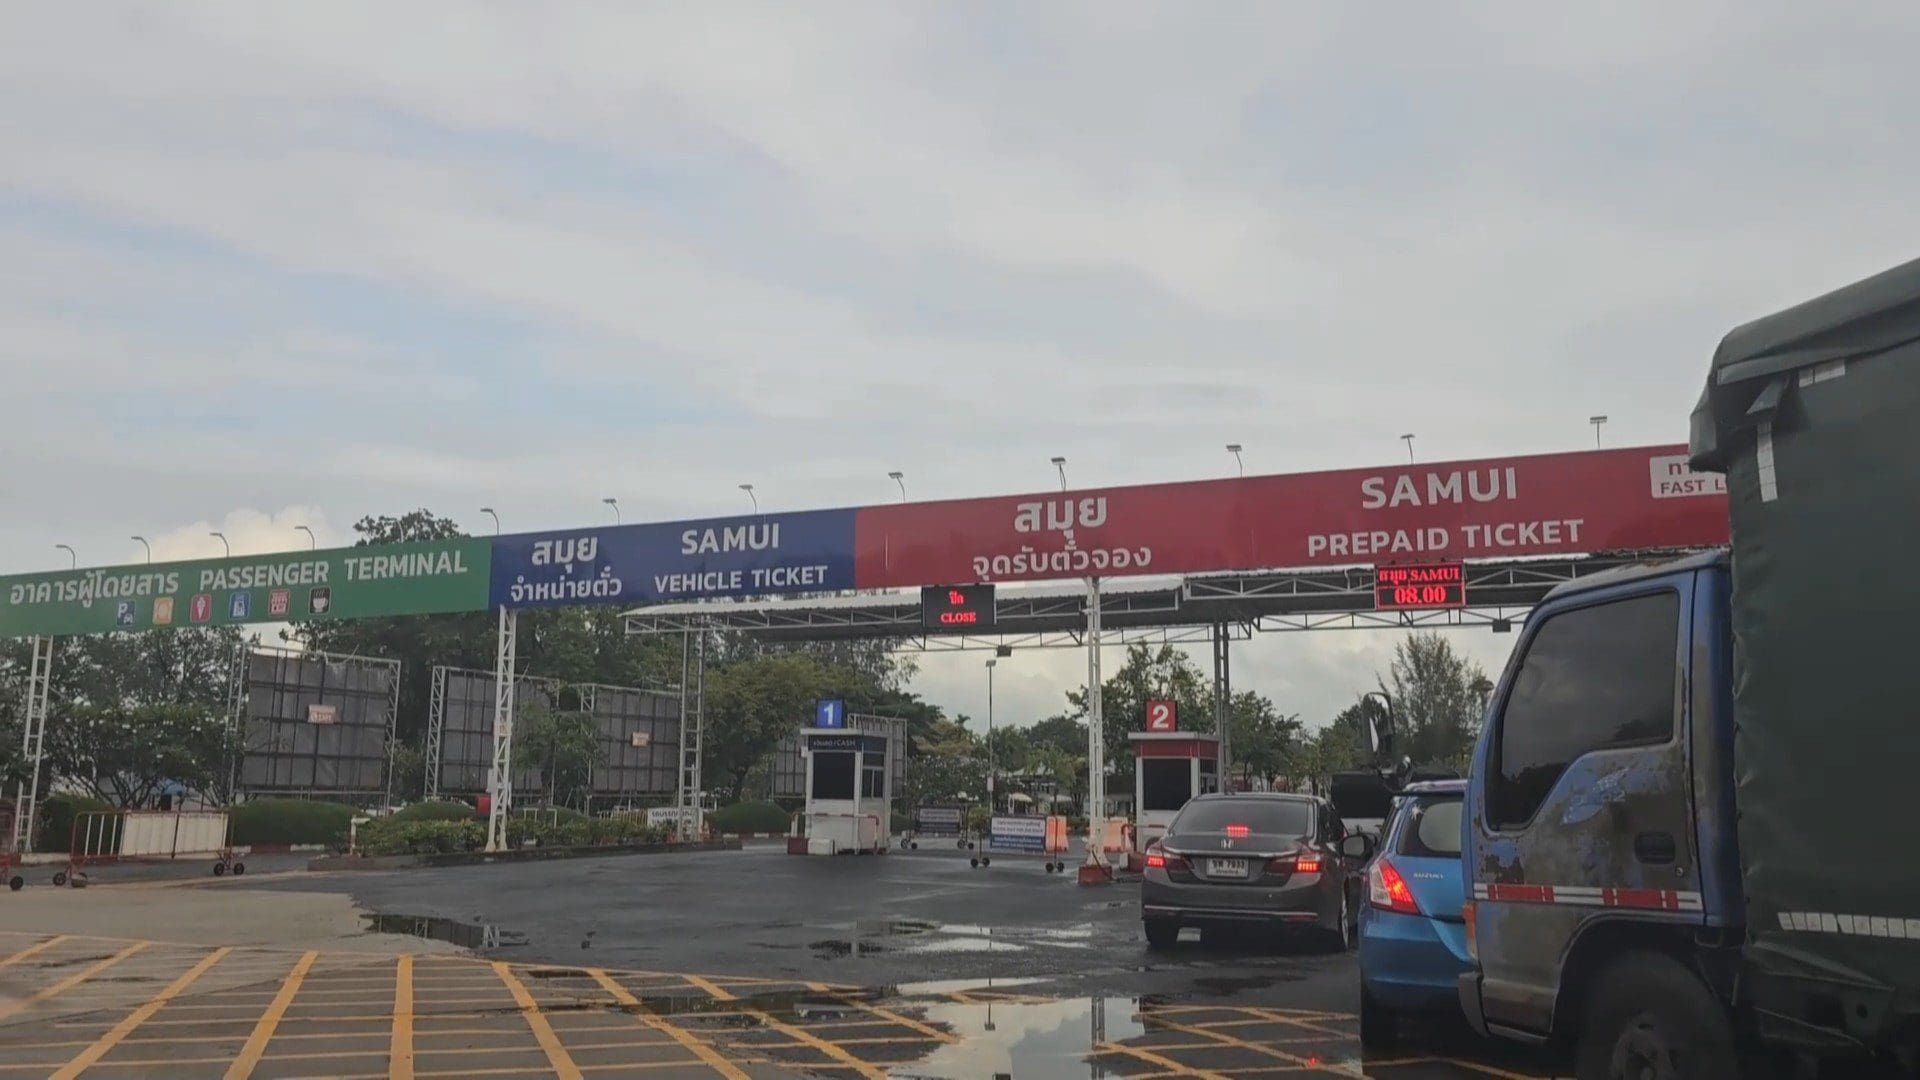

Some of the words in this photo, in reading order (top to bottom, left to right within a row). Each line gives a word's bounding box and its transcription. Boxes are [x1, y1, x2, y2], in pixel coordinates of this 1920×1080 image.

[1361, 467, 1517, 509] SAMUI
[1661, 479, 1705, 494] FAST
[1014, 497, 1107, 539] สมุย
[531, 536, 598, 574] สมุย
[681, 523, 779, 555] SAMUI
[1308, 527, 1449, 557] PREPAID
[1461, 519, 1584, 548] TICKET
[199, 560, 329, 591] PASSENGER
[344, 550, 468, 581] TERMINAL
[973, 539, 1152, 581] จุดรับตั๋วจอง
[1410, 567, 1459, 581] SAMUI
[9, 569, 180, 608] อาคารผู้โดยสาร
[511, 565, 622, 602] จำหน่ายตั๋ว
[654, 570, 742, 593] VEHICLE
[751, 565, 828, 588] TICKET
[1394, 586, 1446, 604] 08.00
[940, 612, 977, 624] CLOSE
[823, 703, 834, 725] 1
[1152, 704, 1169, 728] 2
